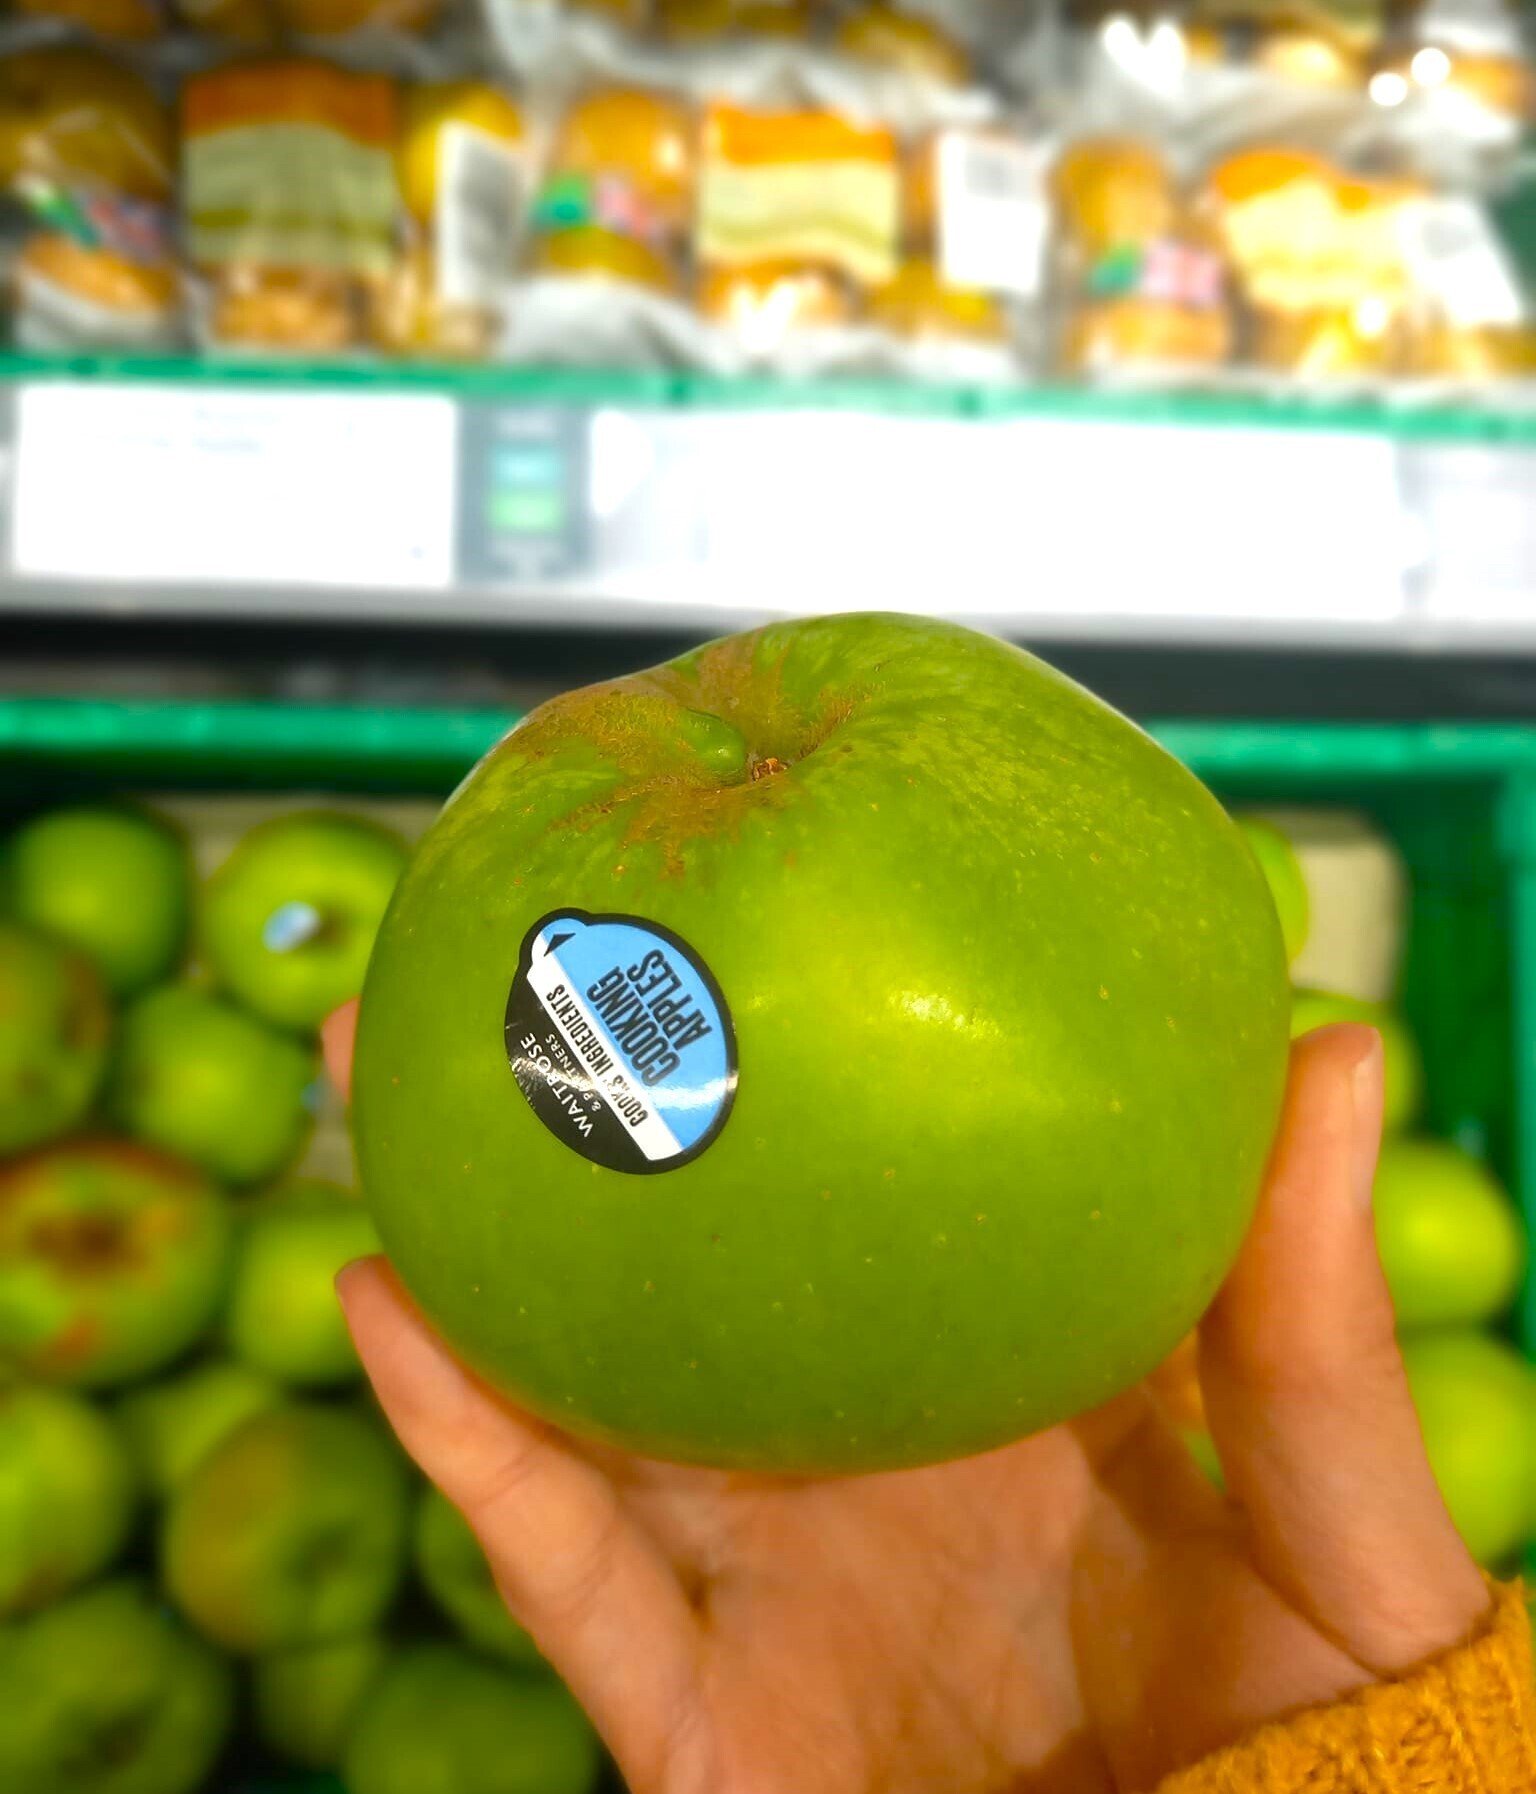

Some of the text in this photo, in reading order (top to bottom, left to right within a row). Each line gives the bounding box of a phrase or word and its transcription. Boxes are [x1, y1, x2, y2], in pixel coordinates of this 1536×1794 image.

[546, 984, 614, 1077] INGREDIENTS
[587, 966, 680, 1086] COOKING
[627, 949, 712, 1050] APPLES
[520, 1033, 593, 1137] WAITROSE
[545, 1034, 601, 1112] & PTNERS
